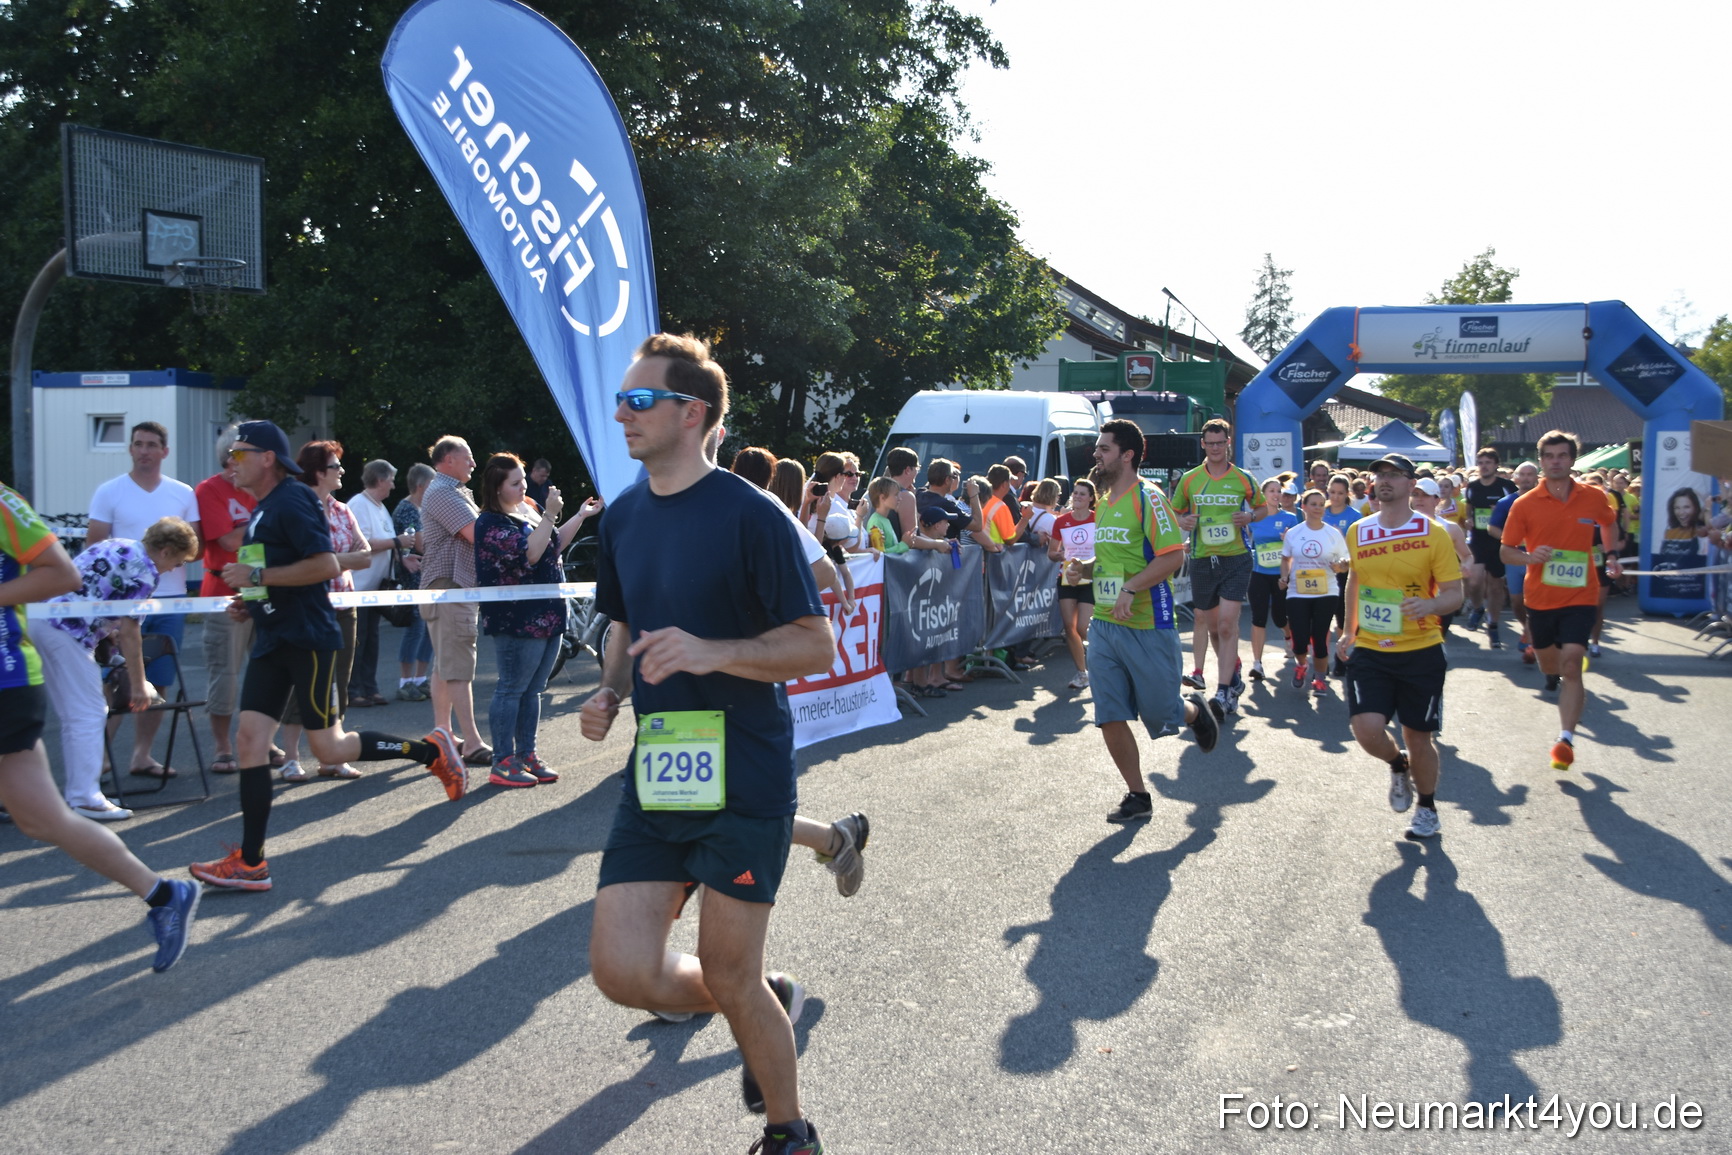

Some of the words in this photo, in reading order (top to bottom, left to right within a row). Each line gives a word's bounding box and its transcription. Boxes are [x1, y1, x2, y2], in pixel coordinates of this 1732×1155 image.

[1466, 323, 1497, 332] Fischer
[1443, 337, 1532, 354] firmenlauf
[1287, 368, 1332, 379] Fischer
[1193, 493, 1240, 506] BOCK
[1094, 527, 1131, 544] OCK
[1206, 526, 1229, 538] 136
[1357, 546, 1388, 560] MAX
[1392, 539, 1430, 553] BÖGL
[1548, 563, 1584, 578] 1040
[1097, 580, 1117, 596] 141
[1305, 579, 1318, 589] 84
[1158, 580, 1171, 622] online.de
[1364, 604, 1392, 623] 942
[642, 751, 713, 783] 1298
